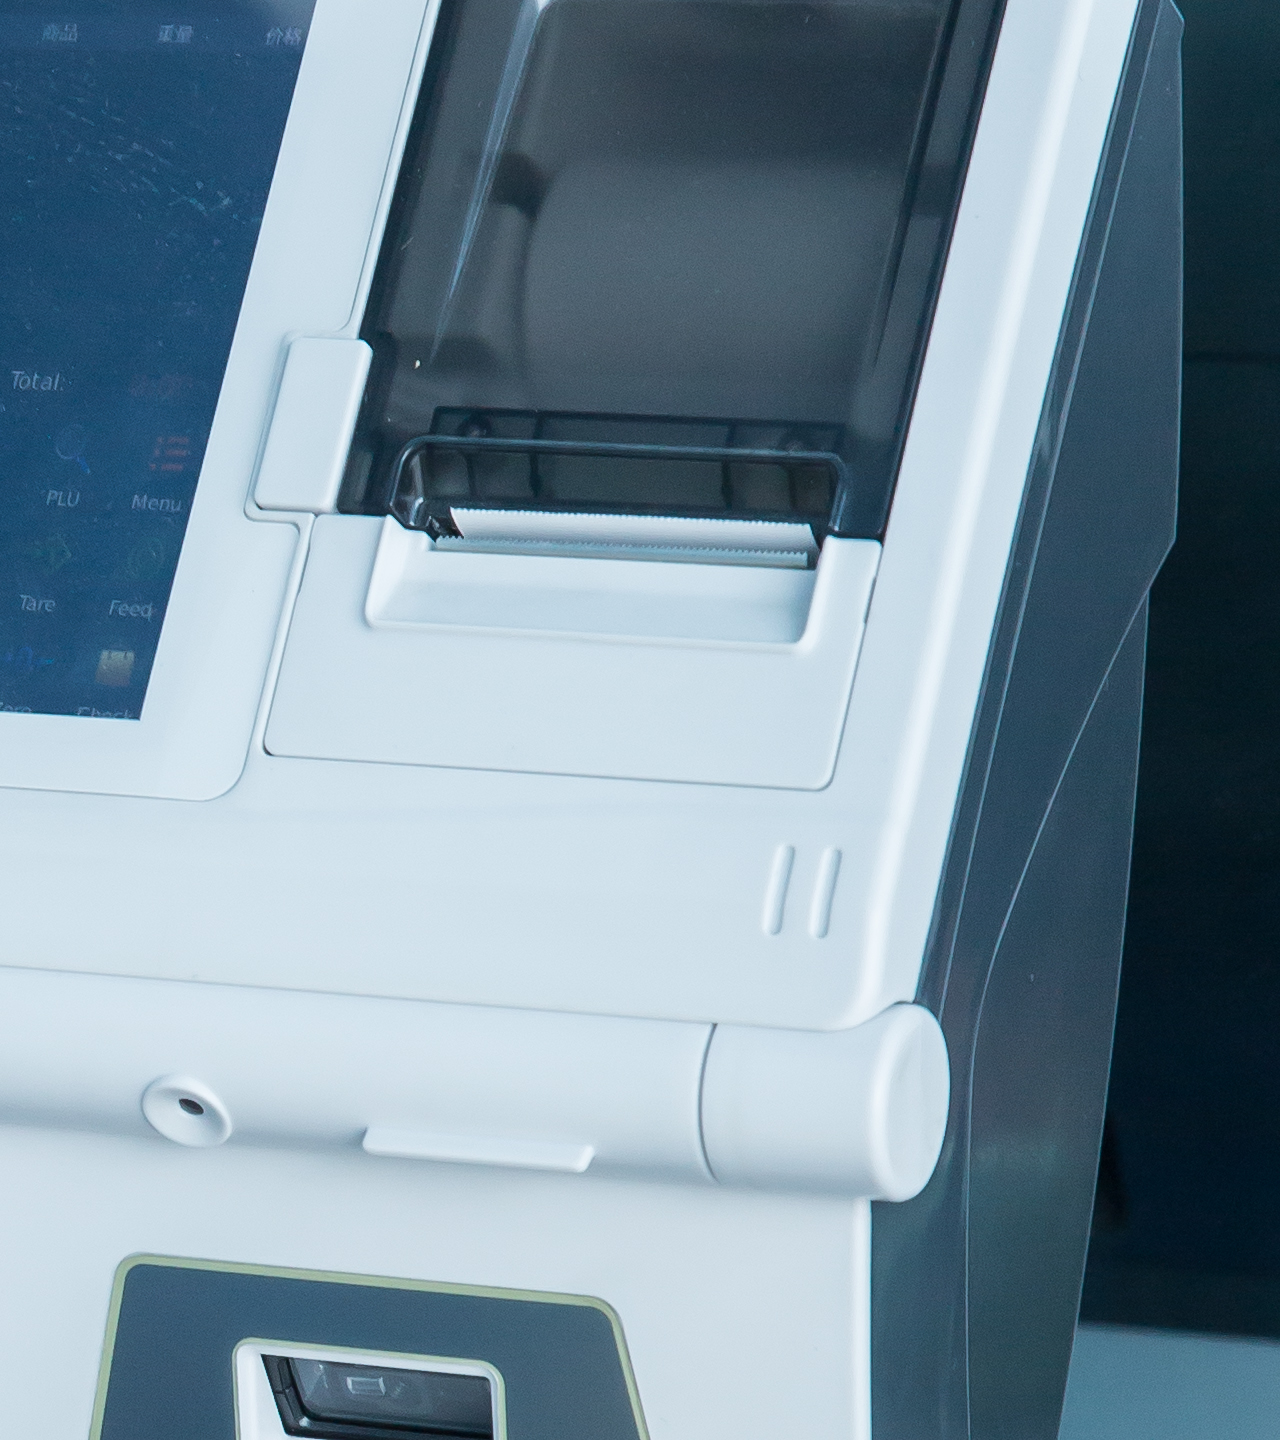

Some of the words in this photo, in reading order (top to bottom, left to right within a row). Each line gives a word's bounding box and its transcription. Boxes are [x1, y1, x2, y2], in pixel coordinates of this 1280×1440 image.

[11, 369, 65, 391] Total:
[45, 489, 80, 508] PLU
[131, 494, 183, 513] Menu
[20, 593, 57, 614] Tare
[108, 598, 153, 618] Feed
